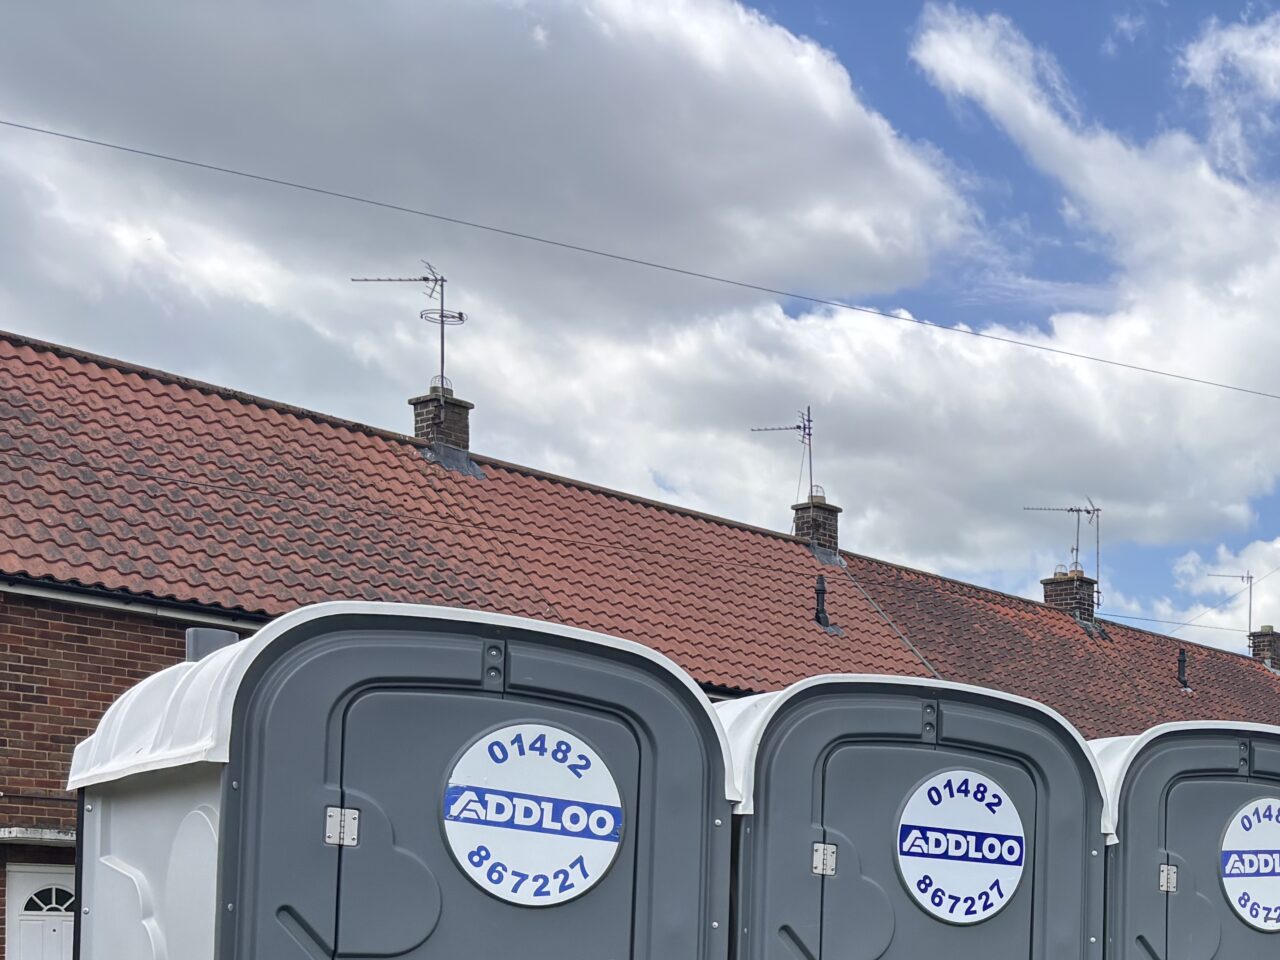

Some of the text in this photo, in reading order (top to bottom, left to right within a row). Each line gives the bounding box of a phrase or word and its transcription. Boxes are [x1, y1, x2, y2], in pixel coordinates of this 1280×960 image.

[487, 733, 591, 779] 01482
[450, 791, 614, 836] ADDLOO
[927, 778, 1002, 814] 01482
[902, 829, 1021, 862] ADDLOO
[467, 845, 589, 897] 867227
[916, 875, 1004, 915] 867227
